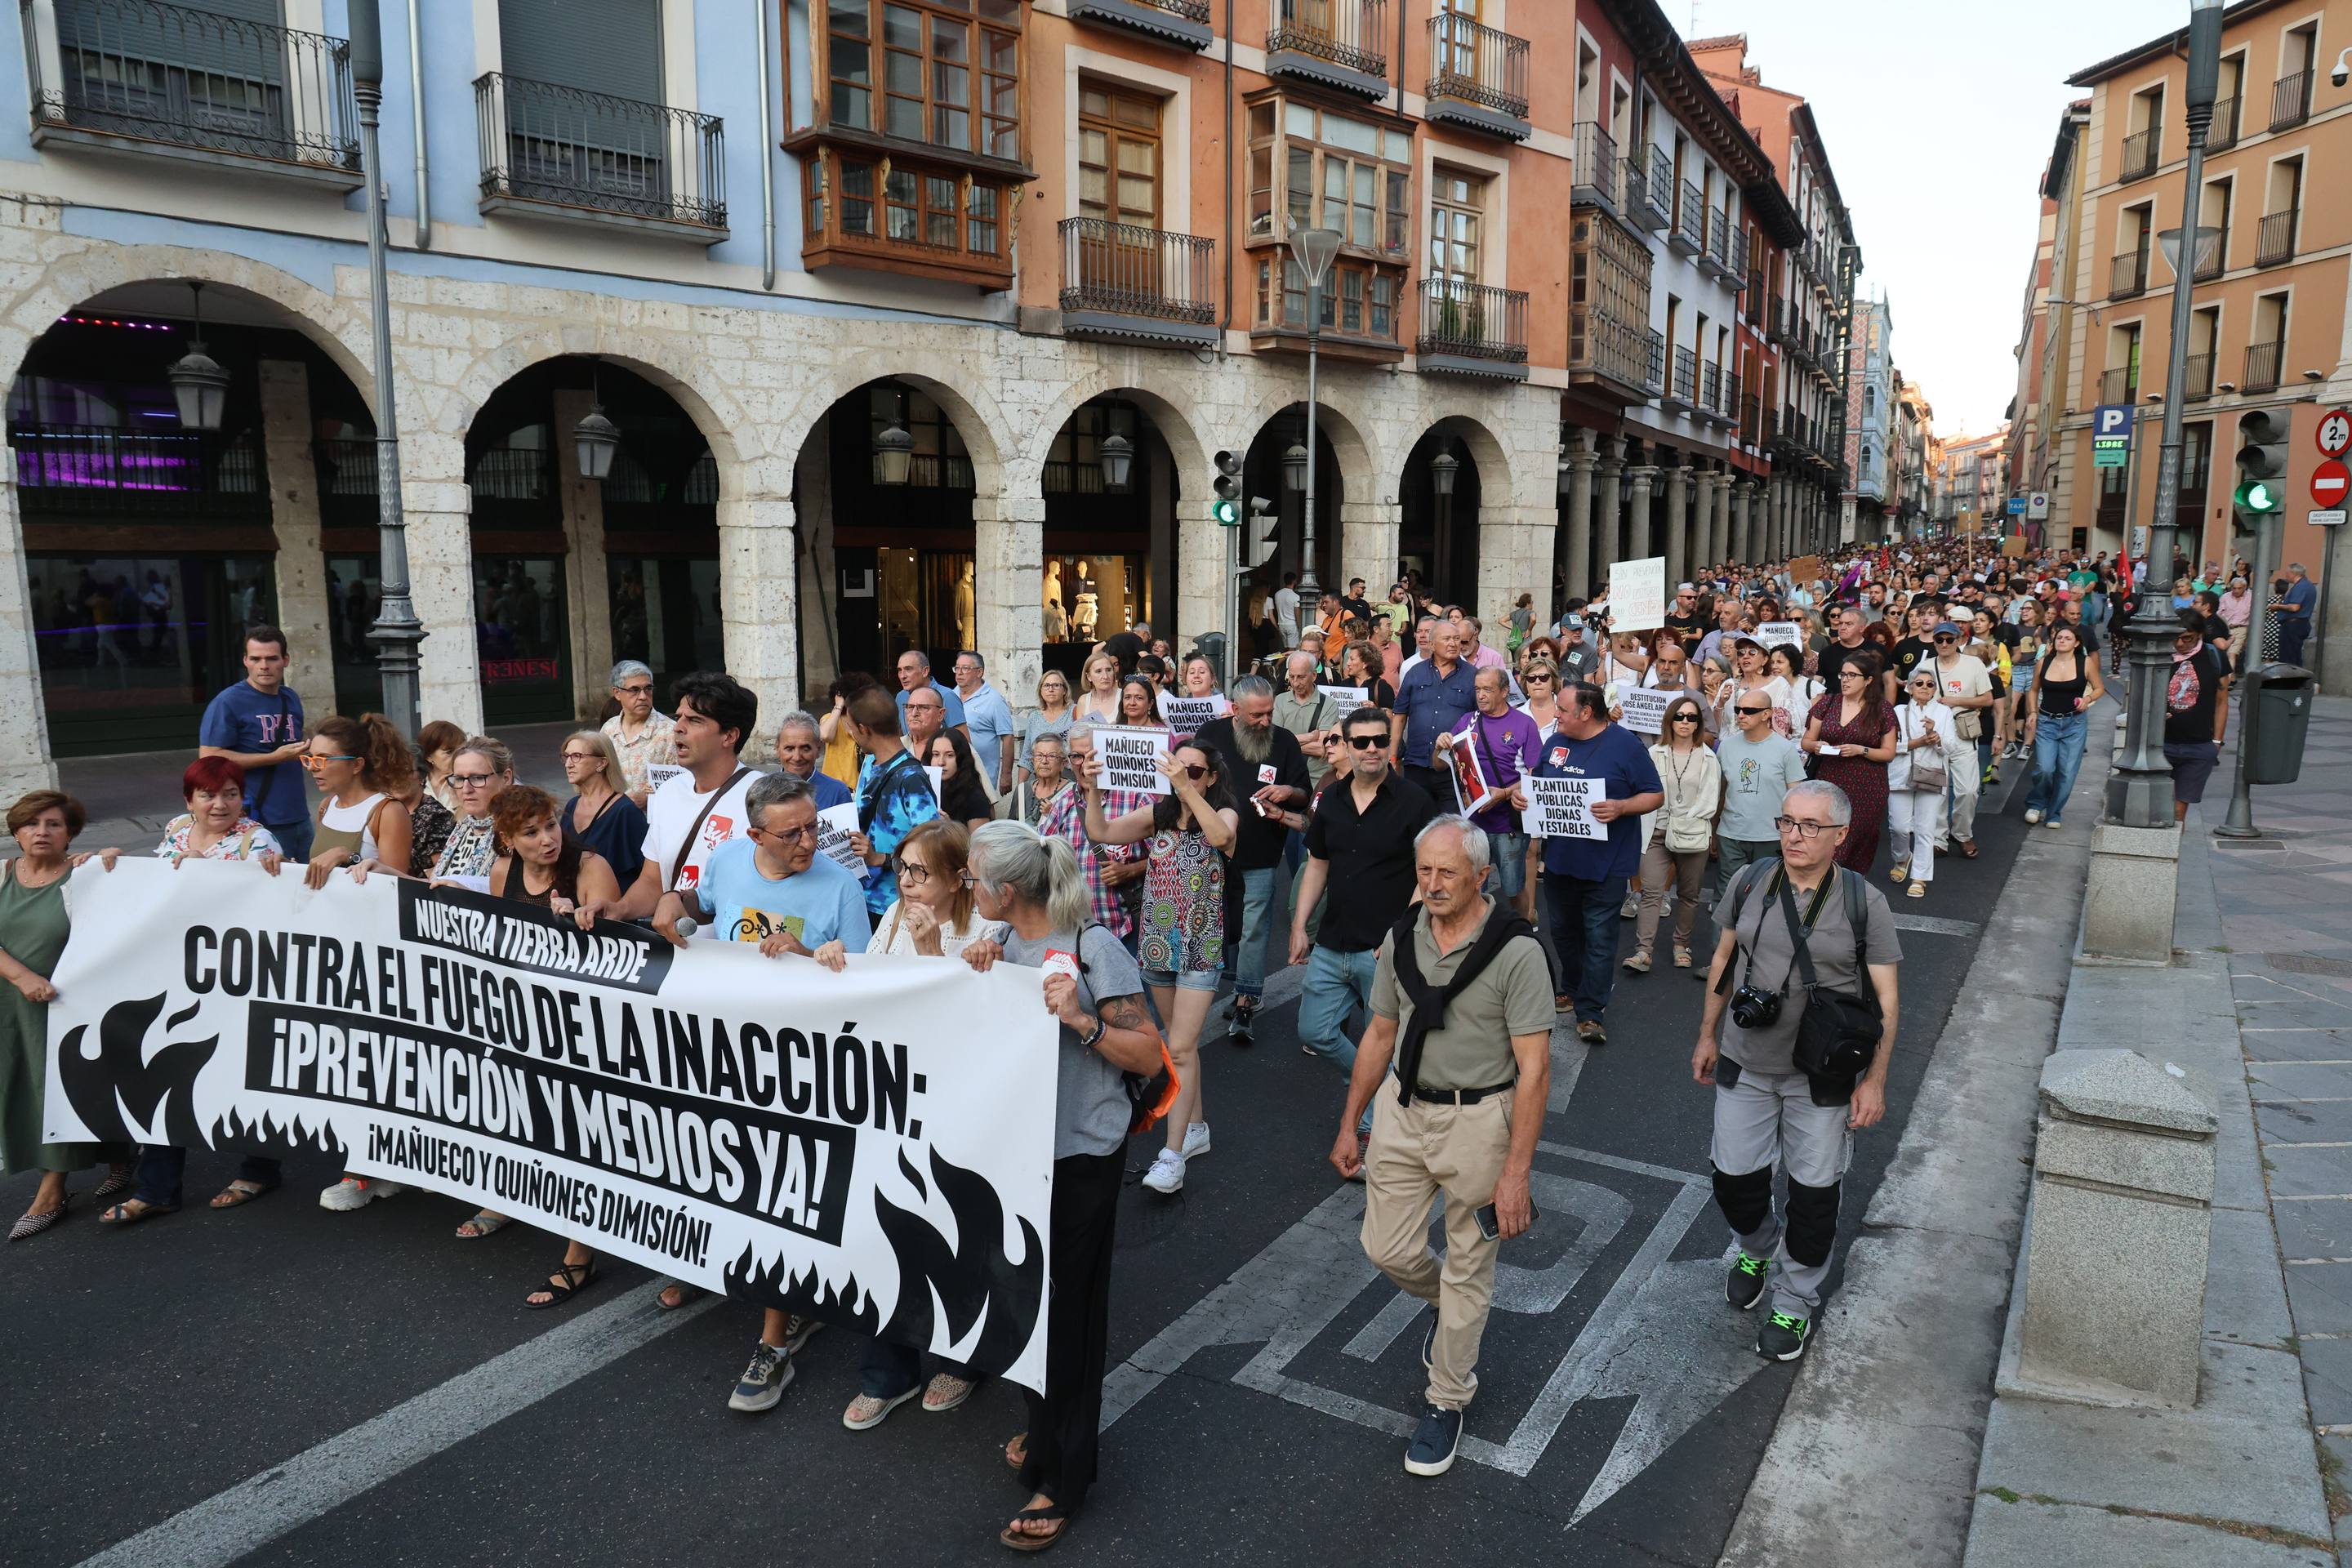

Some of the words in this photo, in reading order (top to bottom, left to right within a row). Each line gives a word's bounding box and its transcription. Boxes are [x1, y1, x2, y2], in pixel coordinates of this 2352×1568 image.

[2102, 410, 2124, 432] P
[1765, 626, 1794, 635] MAÑUECO
[1765, 634, 1794, 643] QUIÑONES
[1167, 702, 1213, 713] MAÑUECO
[1169, 713, 1216, 724] QUIÑONES
[1174, 724, 1200, 733] DIMIS
[1106, 736, 1154, 755] MAÑUECO
[1107, 754, 1156, 773] QUIÑONES
[1563, 766, 1585, 775] adidas
[1111, 772, 1156, 789] DIMISIÓN
[1532, 780, 1588, 794] PLANTILLAS
[1536, 792, 1586, 809] PÚBLICAS,
[1545, 808, 1581, 821] DIGNAS
[1539, 821, 1545, 831] Y
[1547, 821, 1591, 835] ESTABLES
[415, 898, 497, 956] NUESTRA
[499, 916, 580, 972] TIERRA
[578, 935, 651, 984] ARDE
[185, 925, 371, 1012] CONTRA
[377, 945, 417, 1022] EL
[421, 954, 530, 1053] FUEGO
[531, 983, 589, 1068] DE
[590, 996, 652, 1083] LA
[652, 1021, 927, 1140] INACCIÓN:
[270, 1018, 533, 1143] ¡PREVENCIÓN
[537, 1074, 566, 1152] Y
[569, 1083, 745, 1203] MEDIOS
[745, 1125, 829, 1231] YA!
[368, 1123, 474, 1187] ¡MAÑUECO
[479, 1150, 492, 1192] Y
[494, 1158, 597, 1227] QUIÑONES
[599, 1187, 712, 1268] DIMISIÓN!
